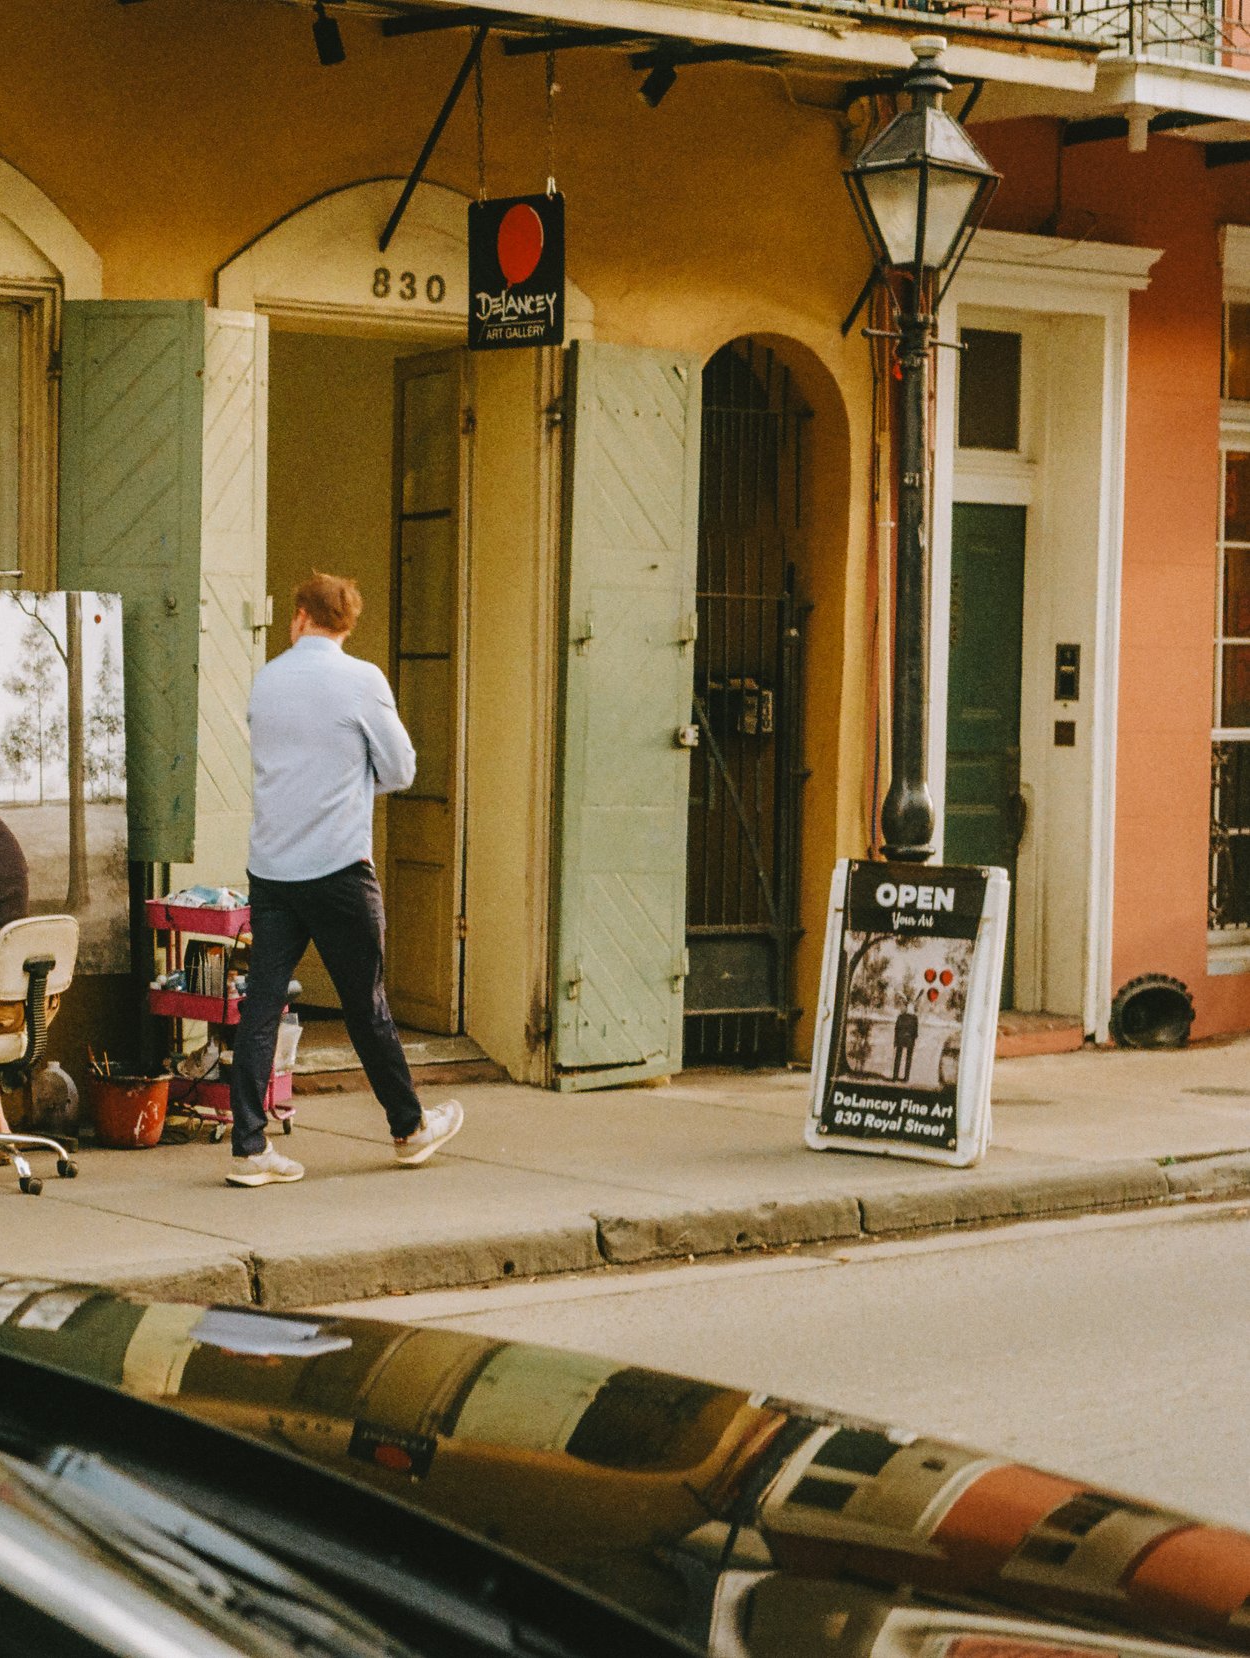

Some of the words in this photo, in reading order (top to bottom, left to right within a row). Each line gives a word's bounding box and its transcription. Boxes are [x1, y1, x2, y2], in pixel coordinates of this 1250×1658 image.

[372, 267, 446, 303] 830
[486, 328, 504, 340] ART
[505, 325, 545, 339] GALLERY
[876, 882, 955, 912] OPEN
[917, 914, 934, 928] Art
[833, 1091, 897, 1115] DeLancey
[900, 1098, 928, 1116] Fine
[931, 1102, 954, 1118] Art
[834, 1110, 862, 1126] 830
[864, 1113, 903, 1132] Royal
[904, 1118, 946, 1137] Street
